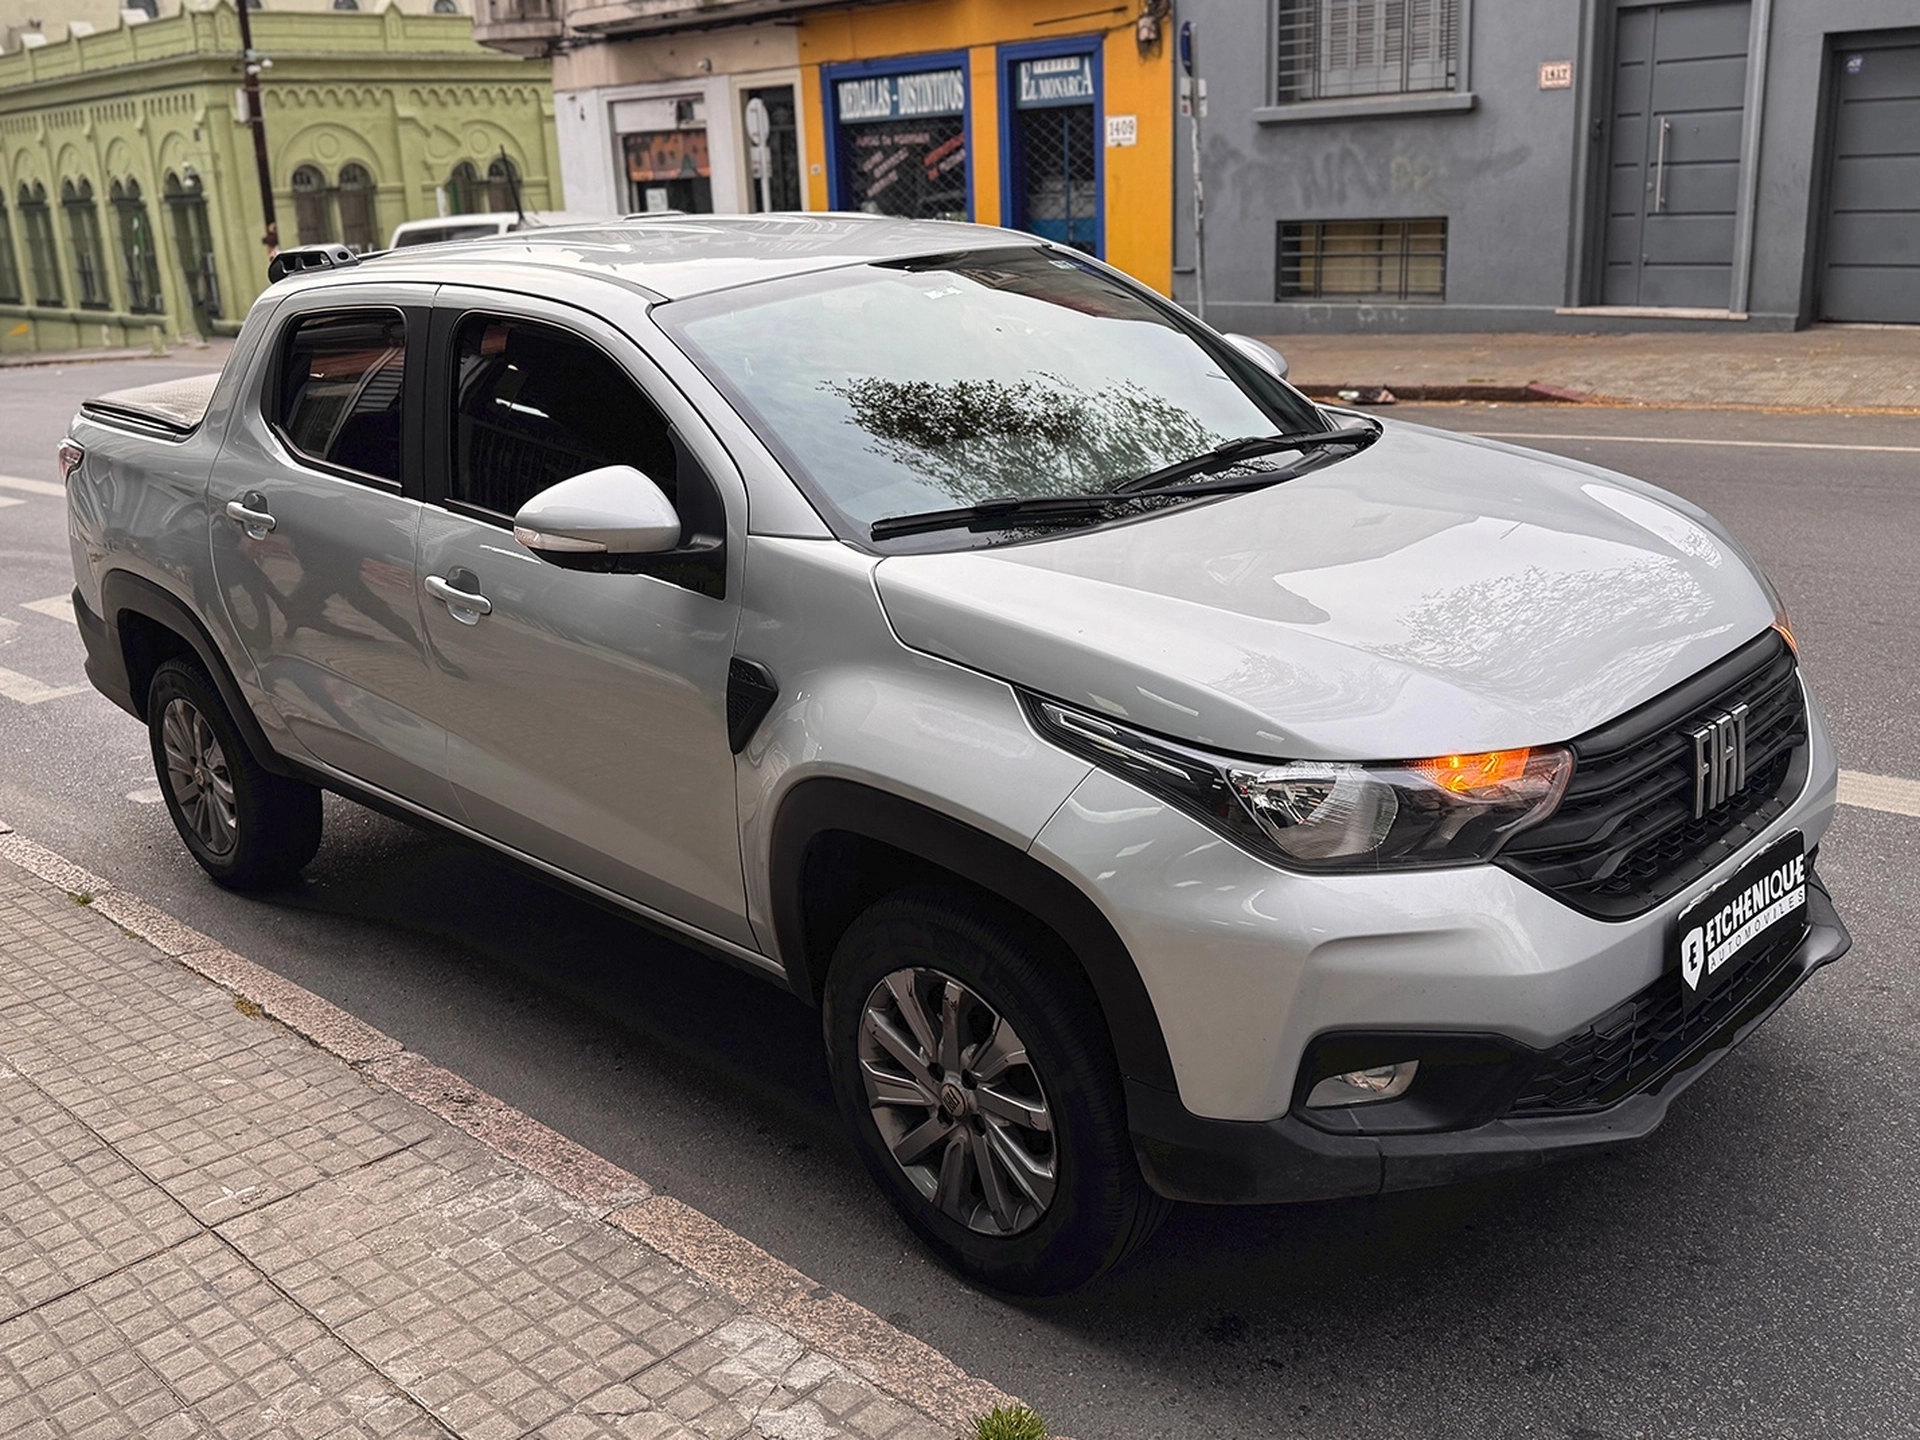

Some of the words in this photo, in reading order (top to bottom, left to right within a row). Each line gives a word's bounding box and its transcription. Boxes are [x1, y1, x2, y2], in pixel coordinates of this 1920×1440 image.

[837, 77, 892, 120] MEDALLAS
[897, 69, 966, 115] DISTINTIVOS
[1038, 57, 1094, 100] MONARCA
[1108, 119, 1135, 137] 1409
[1693, 703, 1749, 820] FIAT
[1705, 852, 1805, 951] ETCHENIQUE
[1709, 889, 1804, 971] AUTOMOVILES
